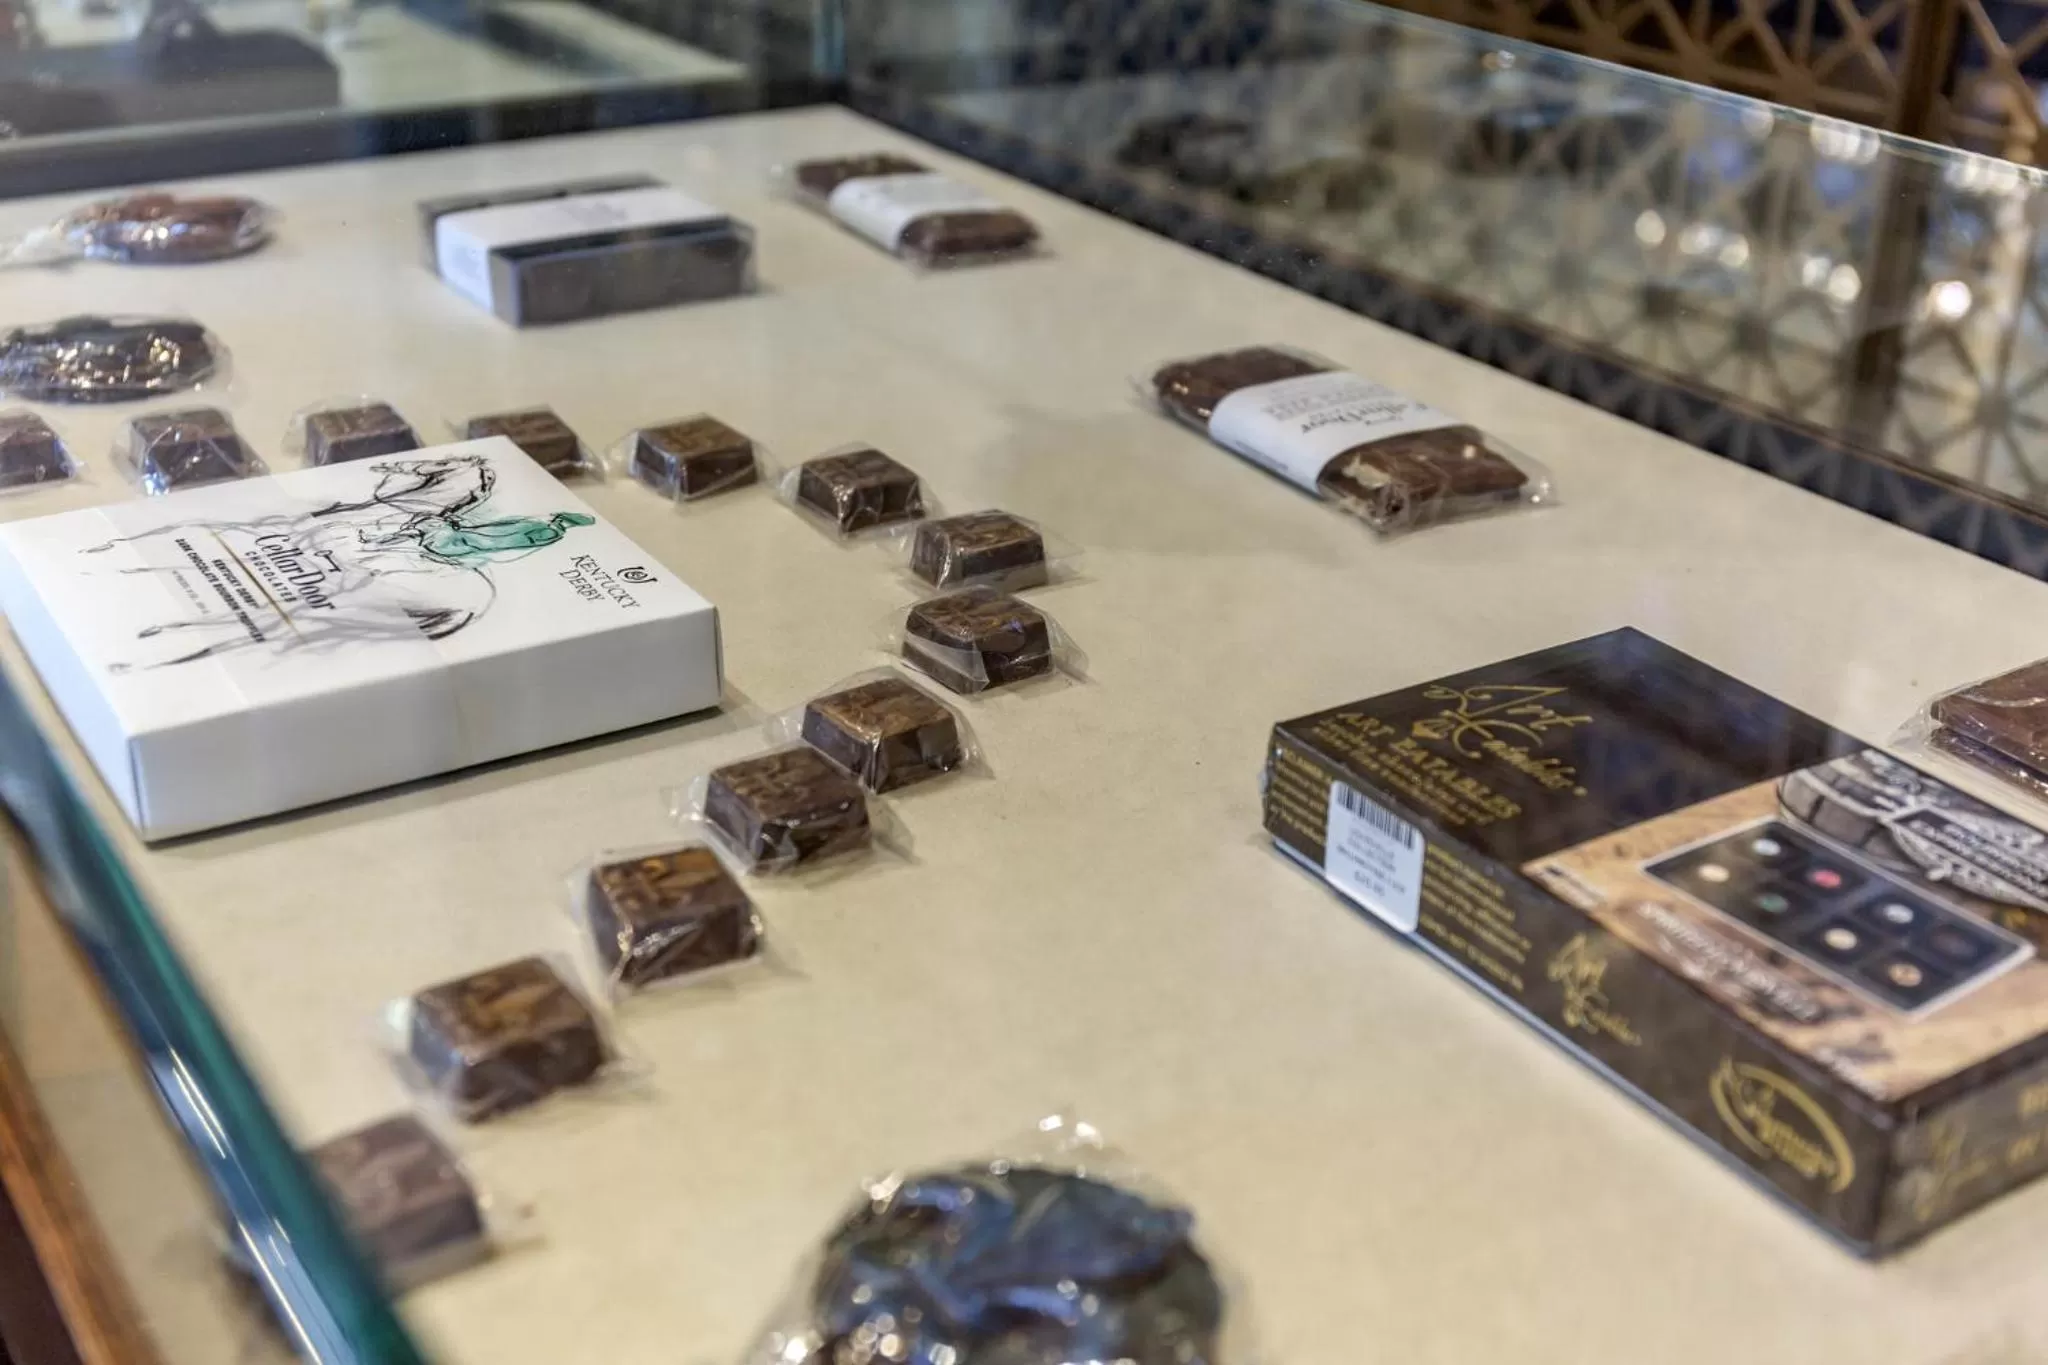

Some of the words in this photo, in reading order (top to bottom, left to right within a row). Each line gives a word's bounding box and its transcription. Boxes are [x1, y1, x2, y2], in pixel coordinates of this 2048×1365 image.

[187, 552, 220, 584] CHOCOLATE
[212, 583, 241, 611] BOURBON
[212, 558, 242, 588] KENTUCKY
[245, 551, 297, 603] CHOCOLATES
[558, 568, 606, 601] DERBY
[569, 554, 641, 608] KENTUCKY
